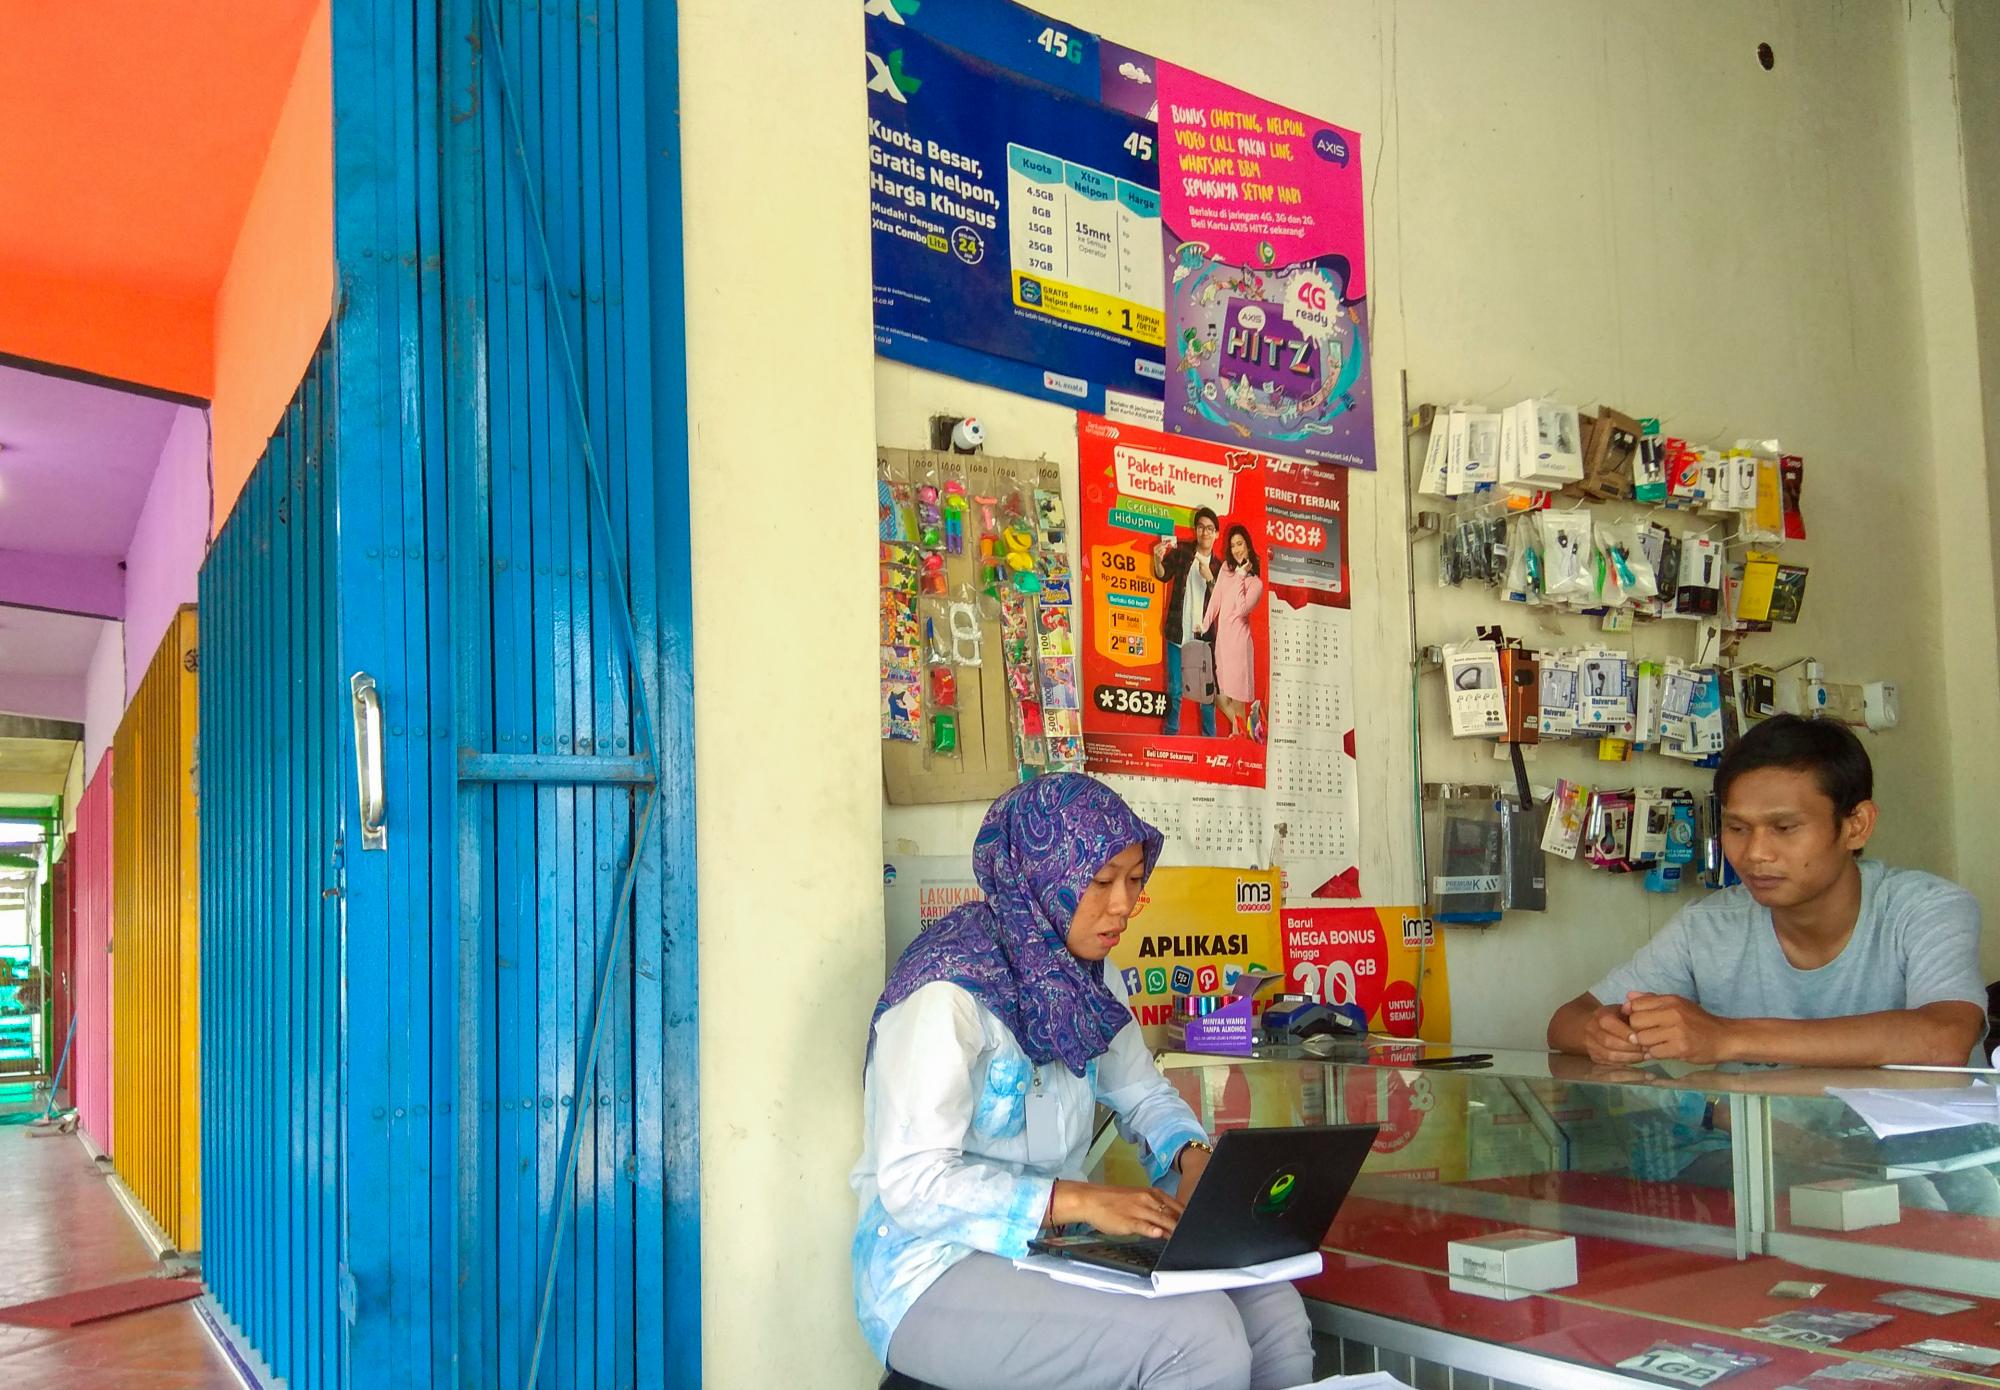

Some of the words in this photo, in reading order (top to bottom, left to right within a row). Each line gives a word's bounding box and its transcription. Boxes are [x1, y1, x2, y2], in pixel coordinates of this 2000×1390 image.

[1171, 104, 1207, 128] BONUS
[868, 117, 922, 155] Kuota
[927, 140, 983, 179] Besar,
[1175, 129, 1206, 150] VIDEO
[1209, 134, 1236, 153] CALL
[1238, 137, 1266, 158] PAKAI
[1316, 139, 1345, 157] AXIS
[1022, 157, 1052, 175] Kuota
[1237, 159, 1261, 178] BBM
[869, 145, 926, 181] Gratis
[930, 167, 1000, 210] Nelpon,
[1080, 170, 1101, 186] Xtra
[1026, 186, 1054, 202] 4.5GB
[1074, 181, 1108, 200] Nelpon
[1182, 177, 1239, 201] SEPUASNYA
[1241, 182, 1274, 203] SETIAP
[1278, 186, 1302, 204] HARI
[870, 171, 926, 207] Harga
[930, 192, 996, 230] Khusus
[1128, 191, 1155, 209] Harga
[871, 202, 907, 222] Mudah!
[909, 214, 945, 235] Dengan
[1032, 206, 1051, 218] 8GB
[1188, 205, 1219, 218] Berlaku
[1219, 209, 1228, 219] di
[1228, 211, 1260, 223] jaringan
[1275, 212, 1287, 223] 3G
[1287, 215, 1302, 224] dan
[872, 218, 894, 235] Xtra
[895, 225, 927, 245] Combo
[929, 235, 947, 251] Lite
[1028, 222, 1053, 236] 15GB
[1075, 222, 1112, 243] 15mnt
[1191, 218, 1206, 228] Beli
[1207, 220, 1229, 231] Kartu
[1229, 222, 1249, 232] AXIS
[1250, 223, 1269, 233] HITZ
[1269, 226, 1305, 239] sekarang!
[959, 237, 977, 255] 24
[1028, 240, 1053, 254] 25GB
[1078, 244, 1107, 259] Operator
[1029, 258, 1053, 272] 37GB
[1042, 286, 1069, 299] GRATIS
[1298, 282, 1326, 310] 4G
[1044, 294, 1068, 308] Nelpon
[1069, 301, 1082, 310] dan
[1083, 304, 1099, 315] SMS
[1121, 309, 1133, 331] 1
[1136, 313, 1160, 326] RUPIAH
[1242, 313, 1262, 325] AXIS
[1296, 308, 1328, 327] ready
[1136, 321, 1158, 334] /DETIK
[1227, 327, 1312, 374] HITZ
[912, 460, 933, 469] 1000
[941, 463, 961, 472] 1000
[969, 464, 988, 474] 1000
[997, 467, 1016, 478] 1000
[1039, 468, 1058, 479] 1000
[1127, 455, 1165, 477] Paket
[1168, 464, 1223, 489] Internet
[1128, 473, 1176, 496] Terbaik
[1126, 499, 1170, 517] Ceriakan
[1299, 494, 1340, 511] TERBAIK
[1114, 512, 1160, 530] Hidupmu
[1101, 551, 1136, 572] 3GB
[1101, 572, 1110, 582] Rp
[1110, 576, 1127, 590] 25
[1129, 579, 1155, 594] RIBU
[1112, 613, 1117, 627] 1
[1111, 636, 1119, 650] 2
[1146, 750, 1157, 758] Beli
[1169, 752, 1194, 763] Sekarang!
[920, 887, 980, 904] LAKUKAN
[1237, 878, 1271, 902] im3
[1288, 918, 1313, 928] Baru!
[1139, 934, 1248, 957] APLIKASI
[1289, 931, 1328, 946] MEGA
[1330, 929, 1376, 945] BONUS
[1289, 949, 1320, 961] hingga
[1354, 958, 1377, 976] GB
[1389, 999, 1415, 1010] UNTUK
[1226, 1017, 1246, 1025] WANGI
[1389, 1012, 1416, 1021] SEMUA
[1641, 1354, 1717, 1380] 1GB
